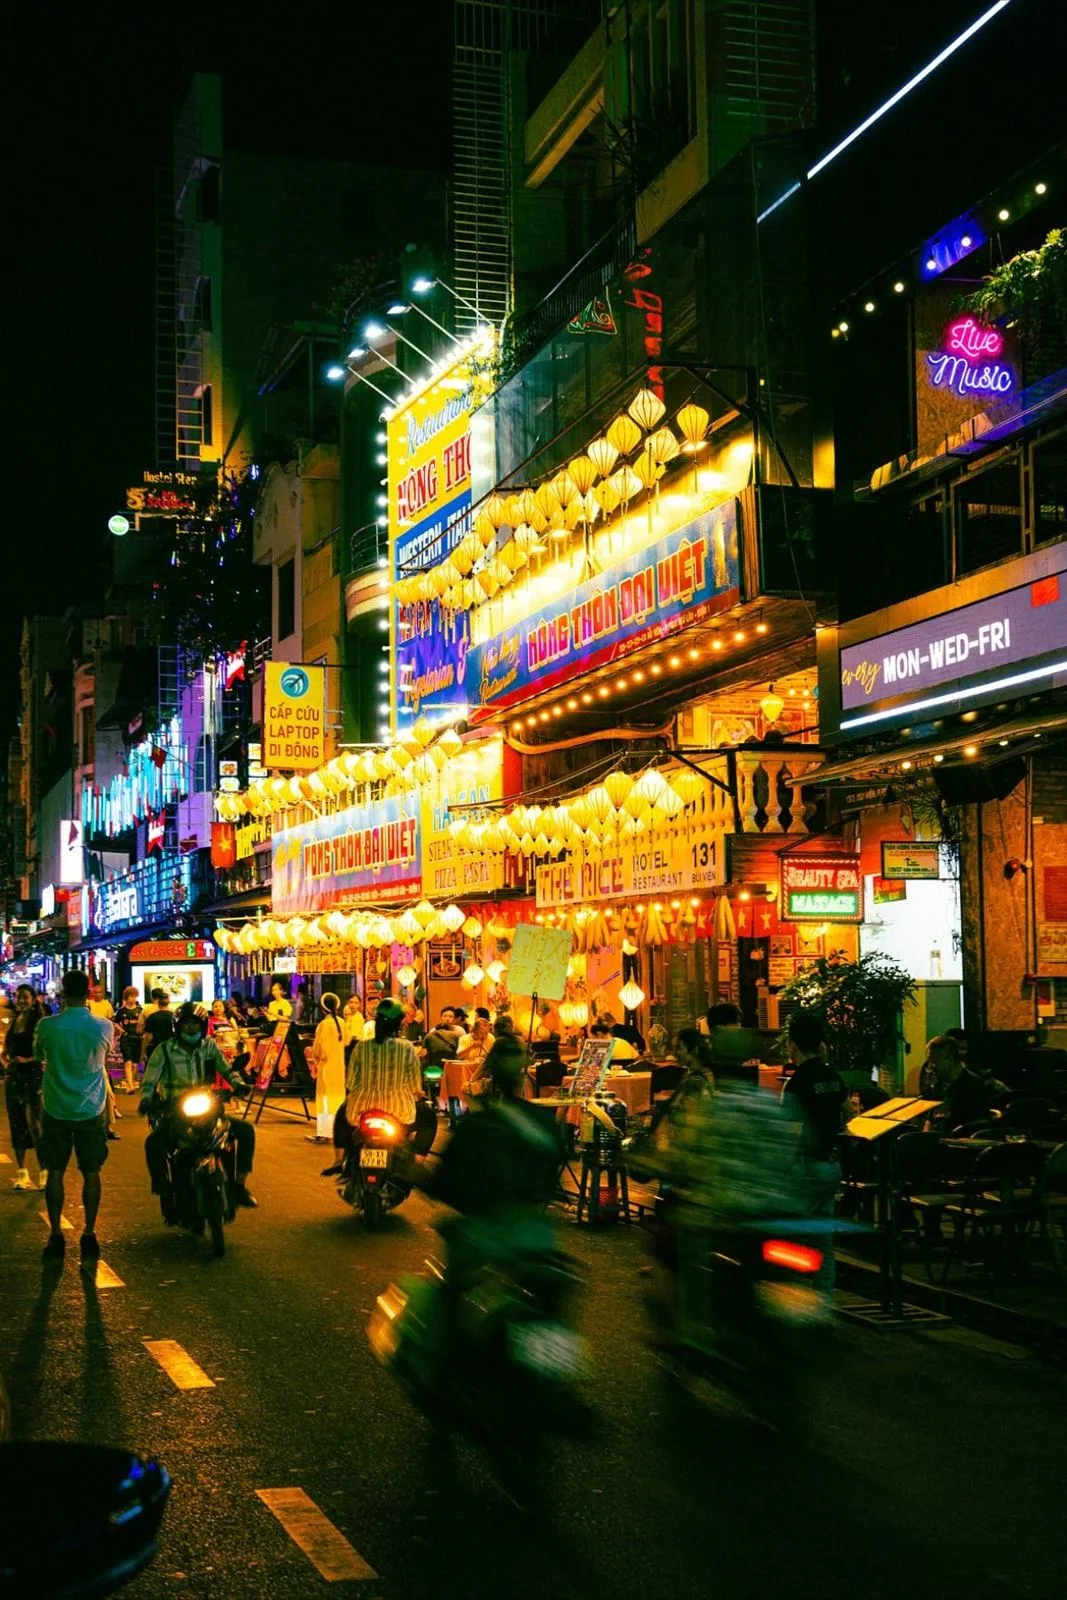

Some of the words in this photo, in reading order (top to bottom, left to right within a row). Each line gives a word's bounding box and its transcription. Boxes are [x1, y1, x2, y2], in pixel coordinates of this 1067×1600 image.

[951, 319, 1000, 357] Live
[928, 355, 1012, 394] Music
[841, 659, 881, 695] every
[883, 618, 1010, 684] MON-WED-FRI
[269, 702, 292, 719] CẤP
[296, 705, 320, 721] CỨU
[269, 725, 320, 740] LAPTOP
[269, 743, 281, 756] DI
[284, 741, 320, 760] ĐỘNG
[632, 849, 668, 873] HOTEL
[691, 841, 717, 868] 131
[581, 857, 625, 898] RICE
[632, 871, 683, 890] RESTAURANT
[787, 866, 834, 889] BEAUTY
[836, 869, 859, 890] SPA
[790, 894, 856, 913] MASSAGE
